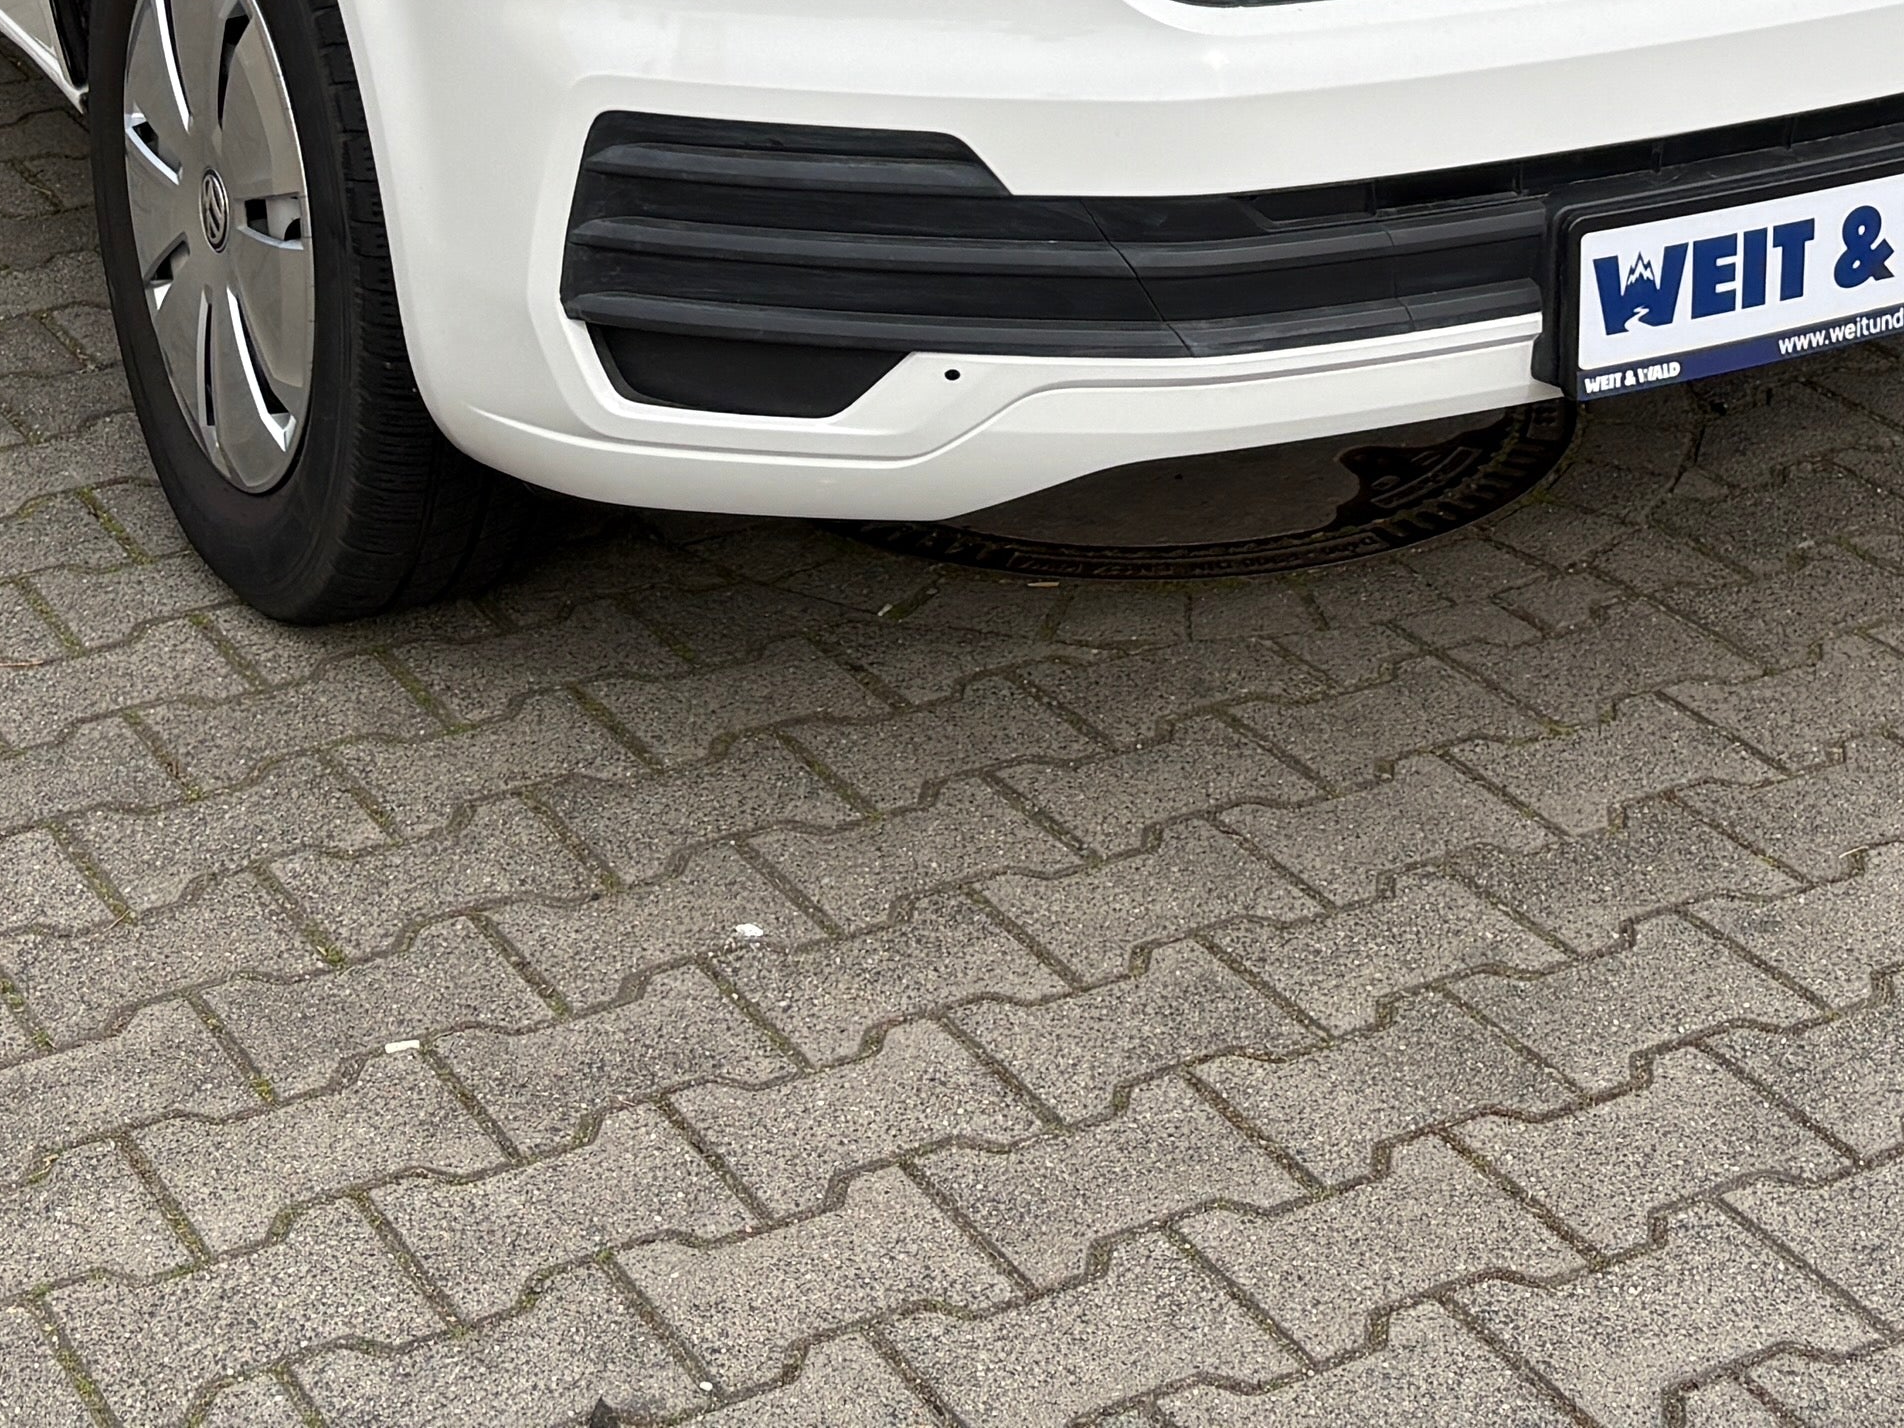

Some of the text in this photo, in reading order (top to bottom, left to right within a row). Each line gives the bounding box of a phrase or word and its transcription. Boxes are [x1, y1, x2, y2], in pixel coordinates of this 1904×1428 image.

[1593, 217, 1815, 336] WEIT
[1832, 204, 1895, 289] &
[1584, 361, 1681, 394] WEIT & WALD
